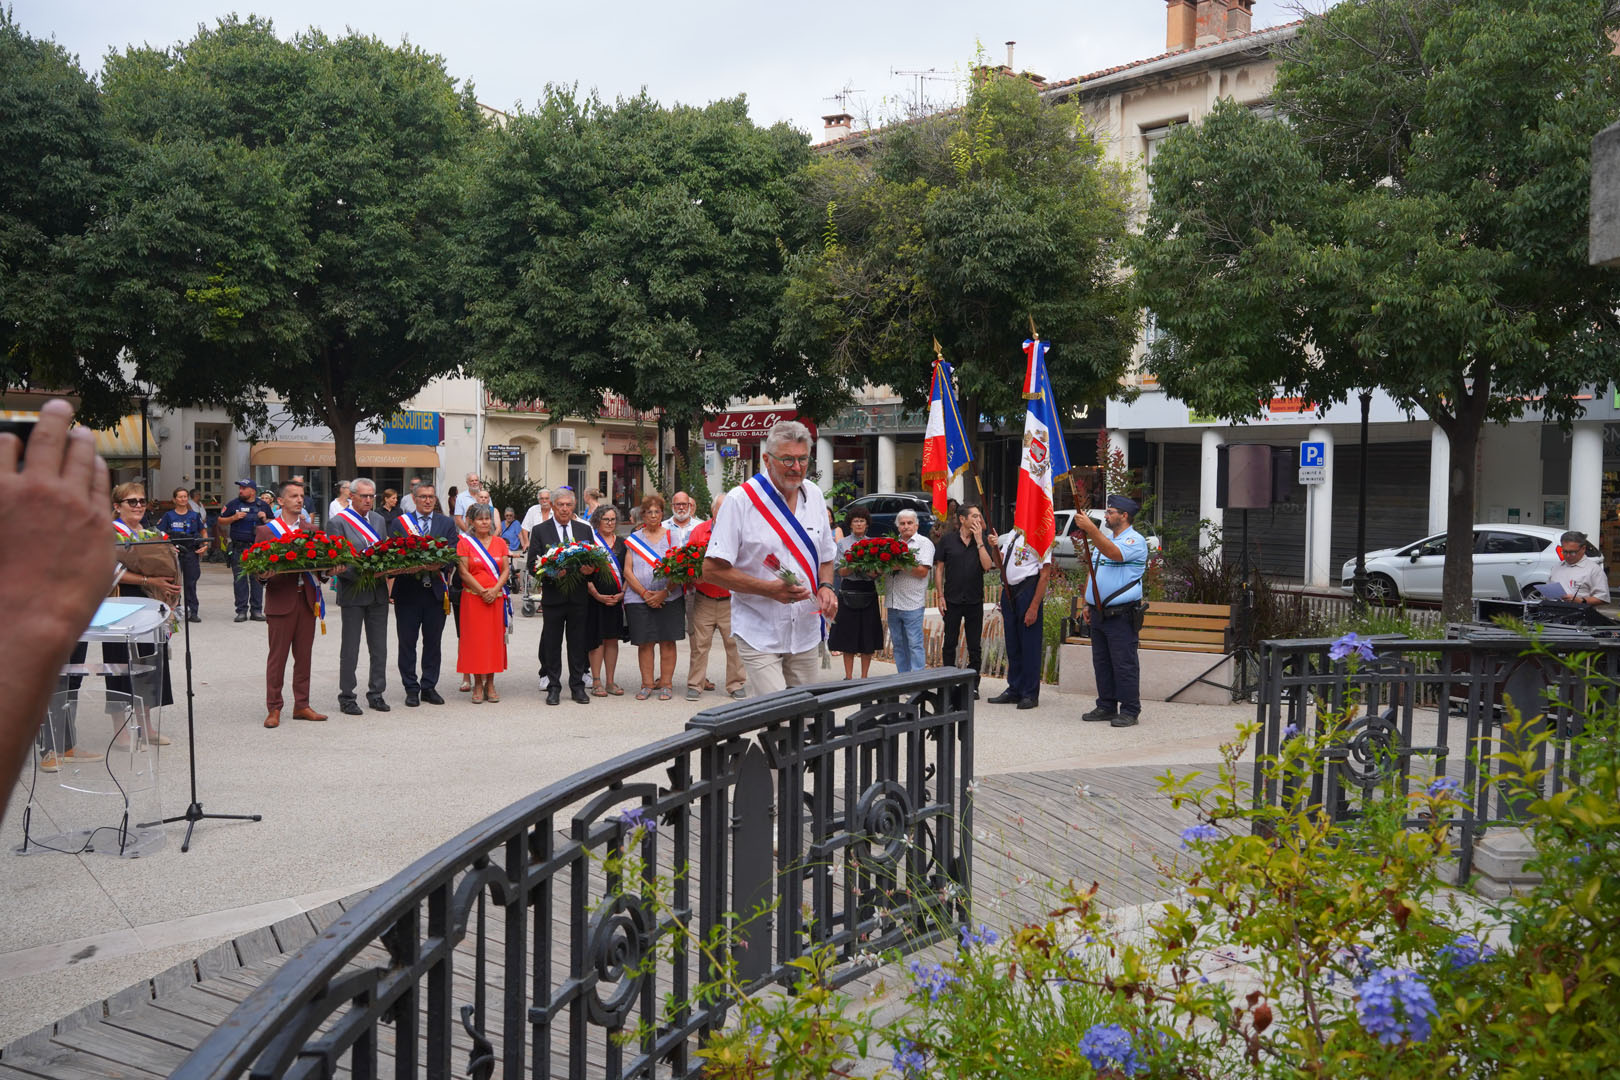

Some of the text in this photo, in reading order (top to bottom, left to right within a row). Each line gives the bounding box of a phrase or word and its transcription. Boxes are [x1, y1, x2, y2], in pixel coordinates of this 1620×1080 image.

[391, 411, 434, 430] BISCUITIER
[718, 415, 738, 430] Le
[1307, 446, 1319, 463] P
